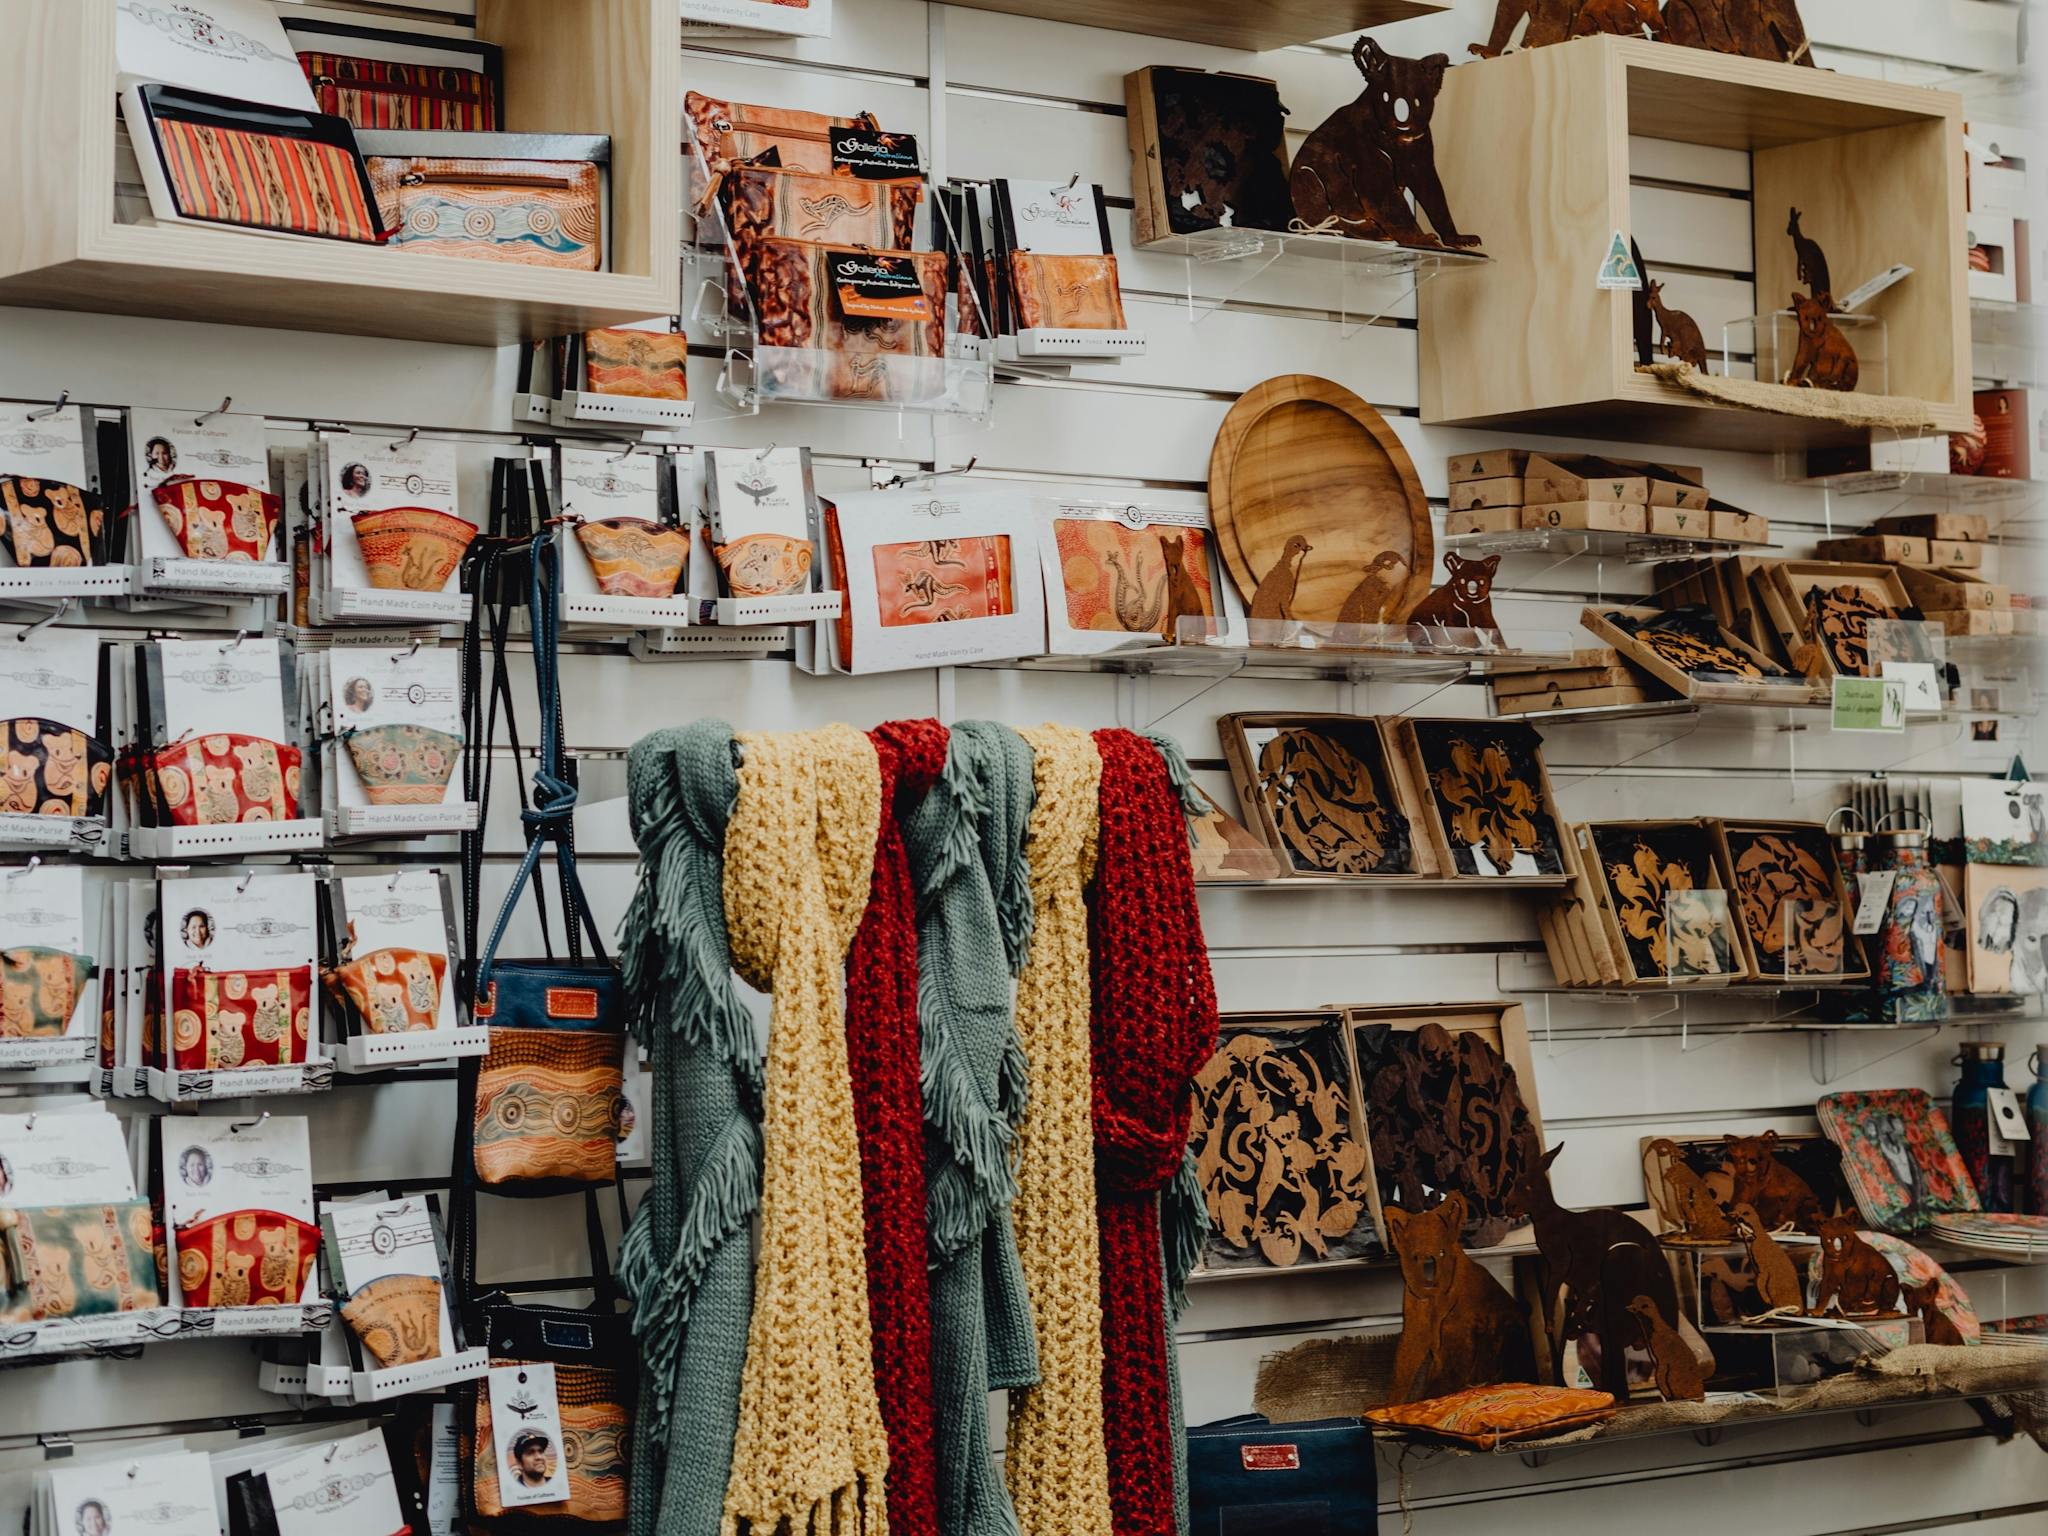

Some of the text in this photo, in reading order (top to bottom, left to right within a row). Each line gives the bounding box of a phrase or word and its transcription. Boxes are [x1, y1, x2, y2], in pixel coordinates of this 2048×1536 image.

[174, 568, 198, 576] Hand
[200, 569, 224, 577] Made
[226, 569, 247, 578] Coin
[360, 598, 455, 611] Hand Made Coin Purse
[335, 634, 406, 644] Hand Made Purse
[368, 812, 462, 823] Hand Made Coin Purse
[11, 824, 37, 832] Made
[39, 825, 64, 834] Purse
[24, 1047, 47, 1056] Coin
[49, 1046, 75, 1055] Purse
[220, 1076, 295, 1087] Hand Made Purse
[221, 1314, 295, 1326] Hand Made Purse
